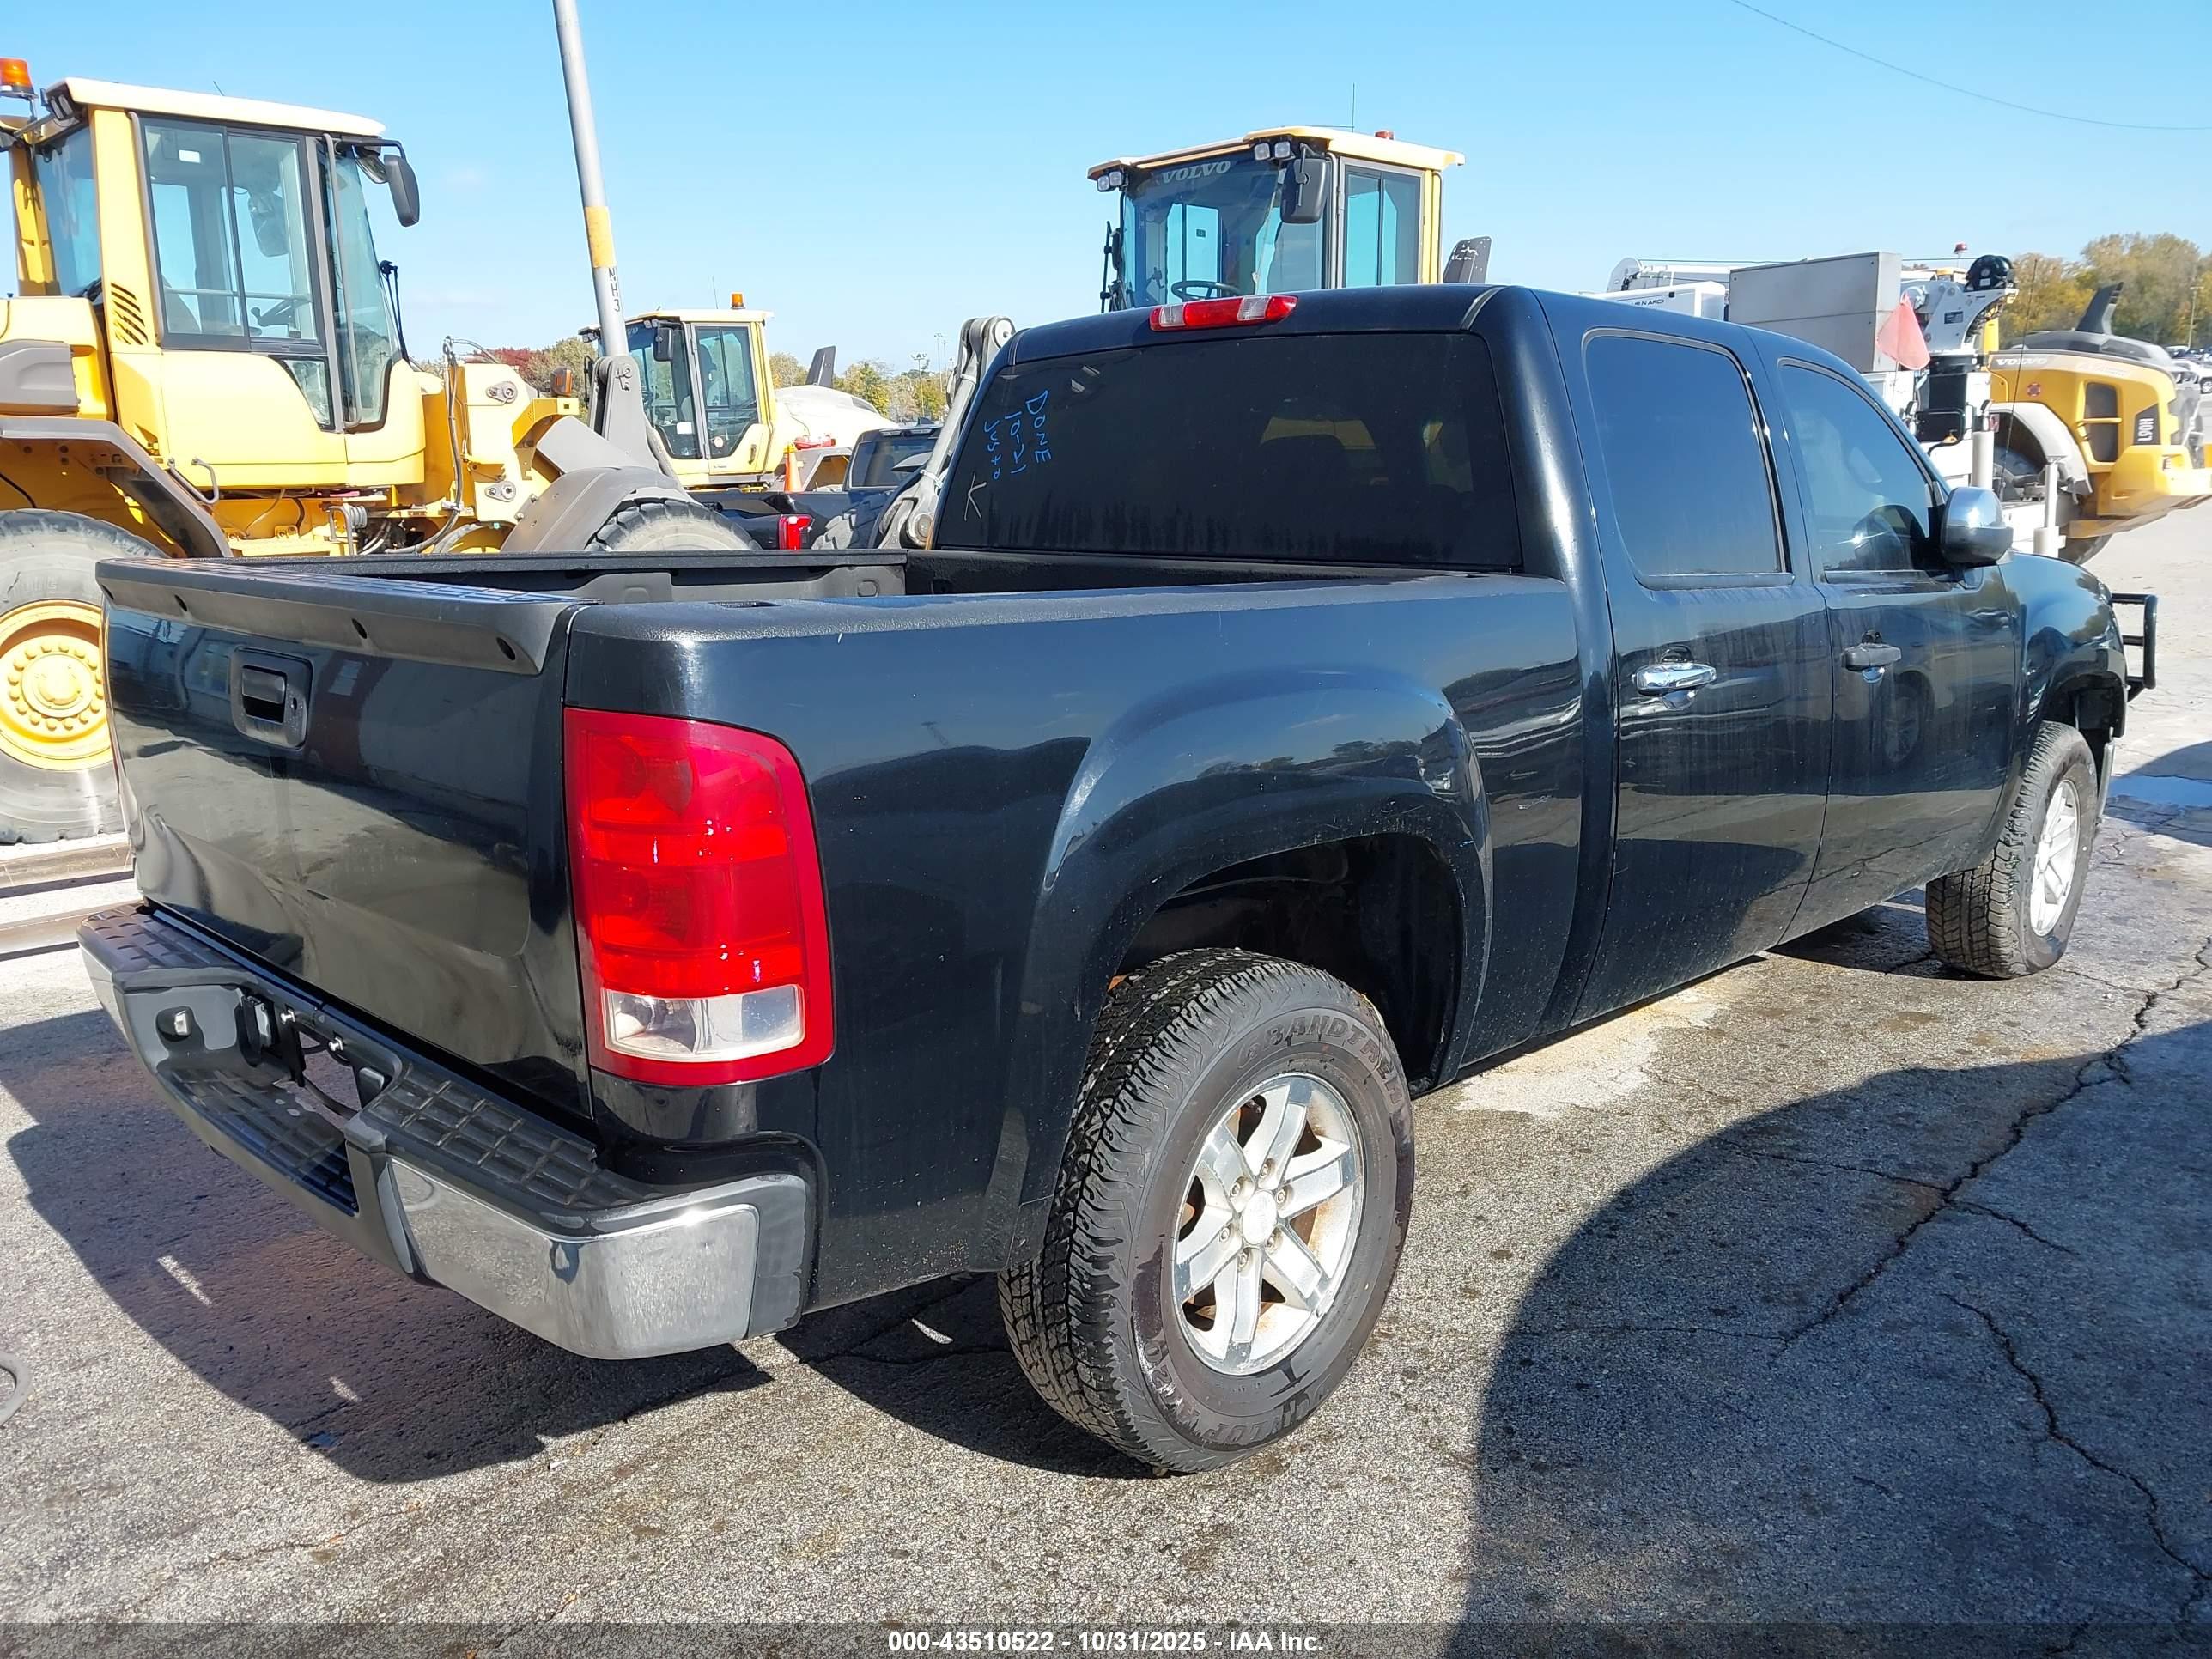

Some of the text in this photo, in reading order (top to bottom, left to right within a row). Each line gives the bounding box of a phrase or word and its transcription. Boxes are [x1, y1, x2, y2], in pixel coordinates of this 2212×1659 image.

[1161, 161, 1231, 184] VOLVO
[1996, 357, 2048, 366] VOLVO
[1025, 390, 1052, 464] DONE
[2137, 418, 2154, 441] L90H
[1004, 411, 1027, 474] 10-21
